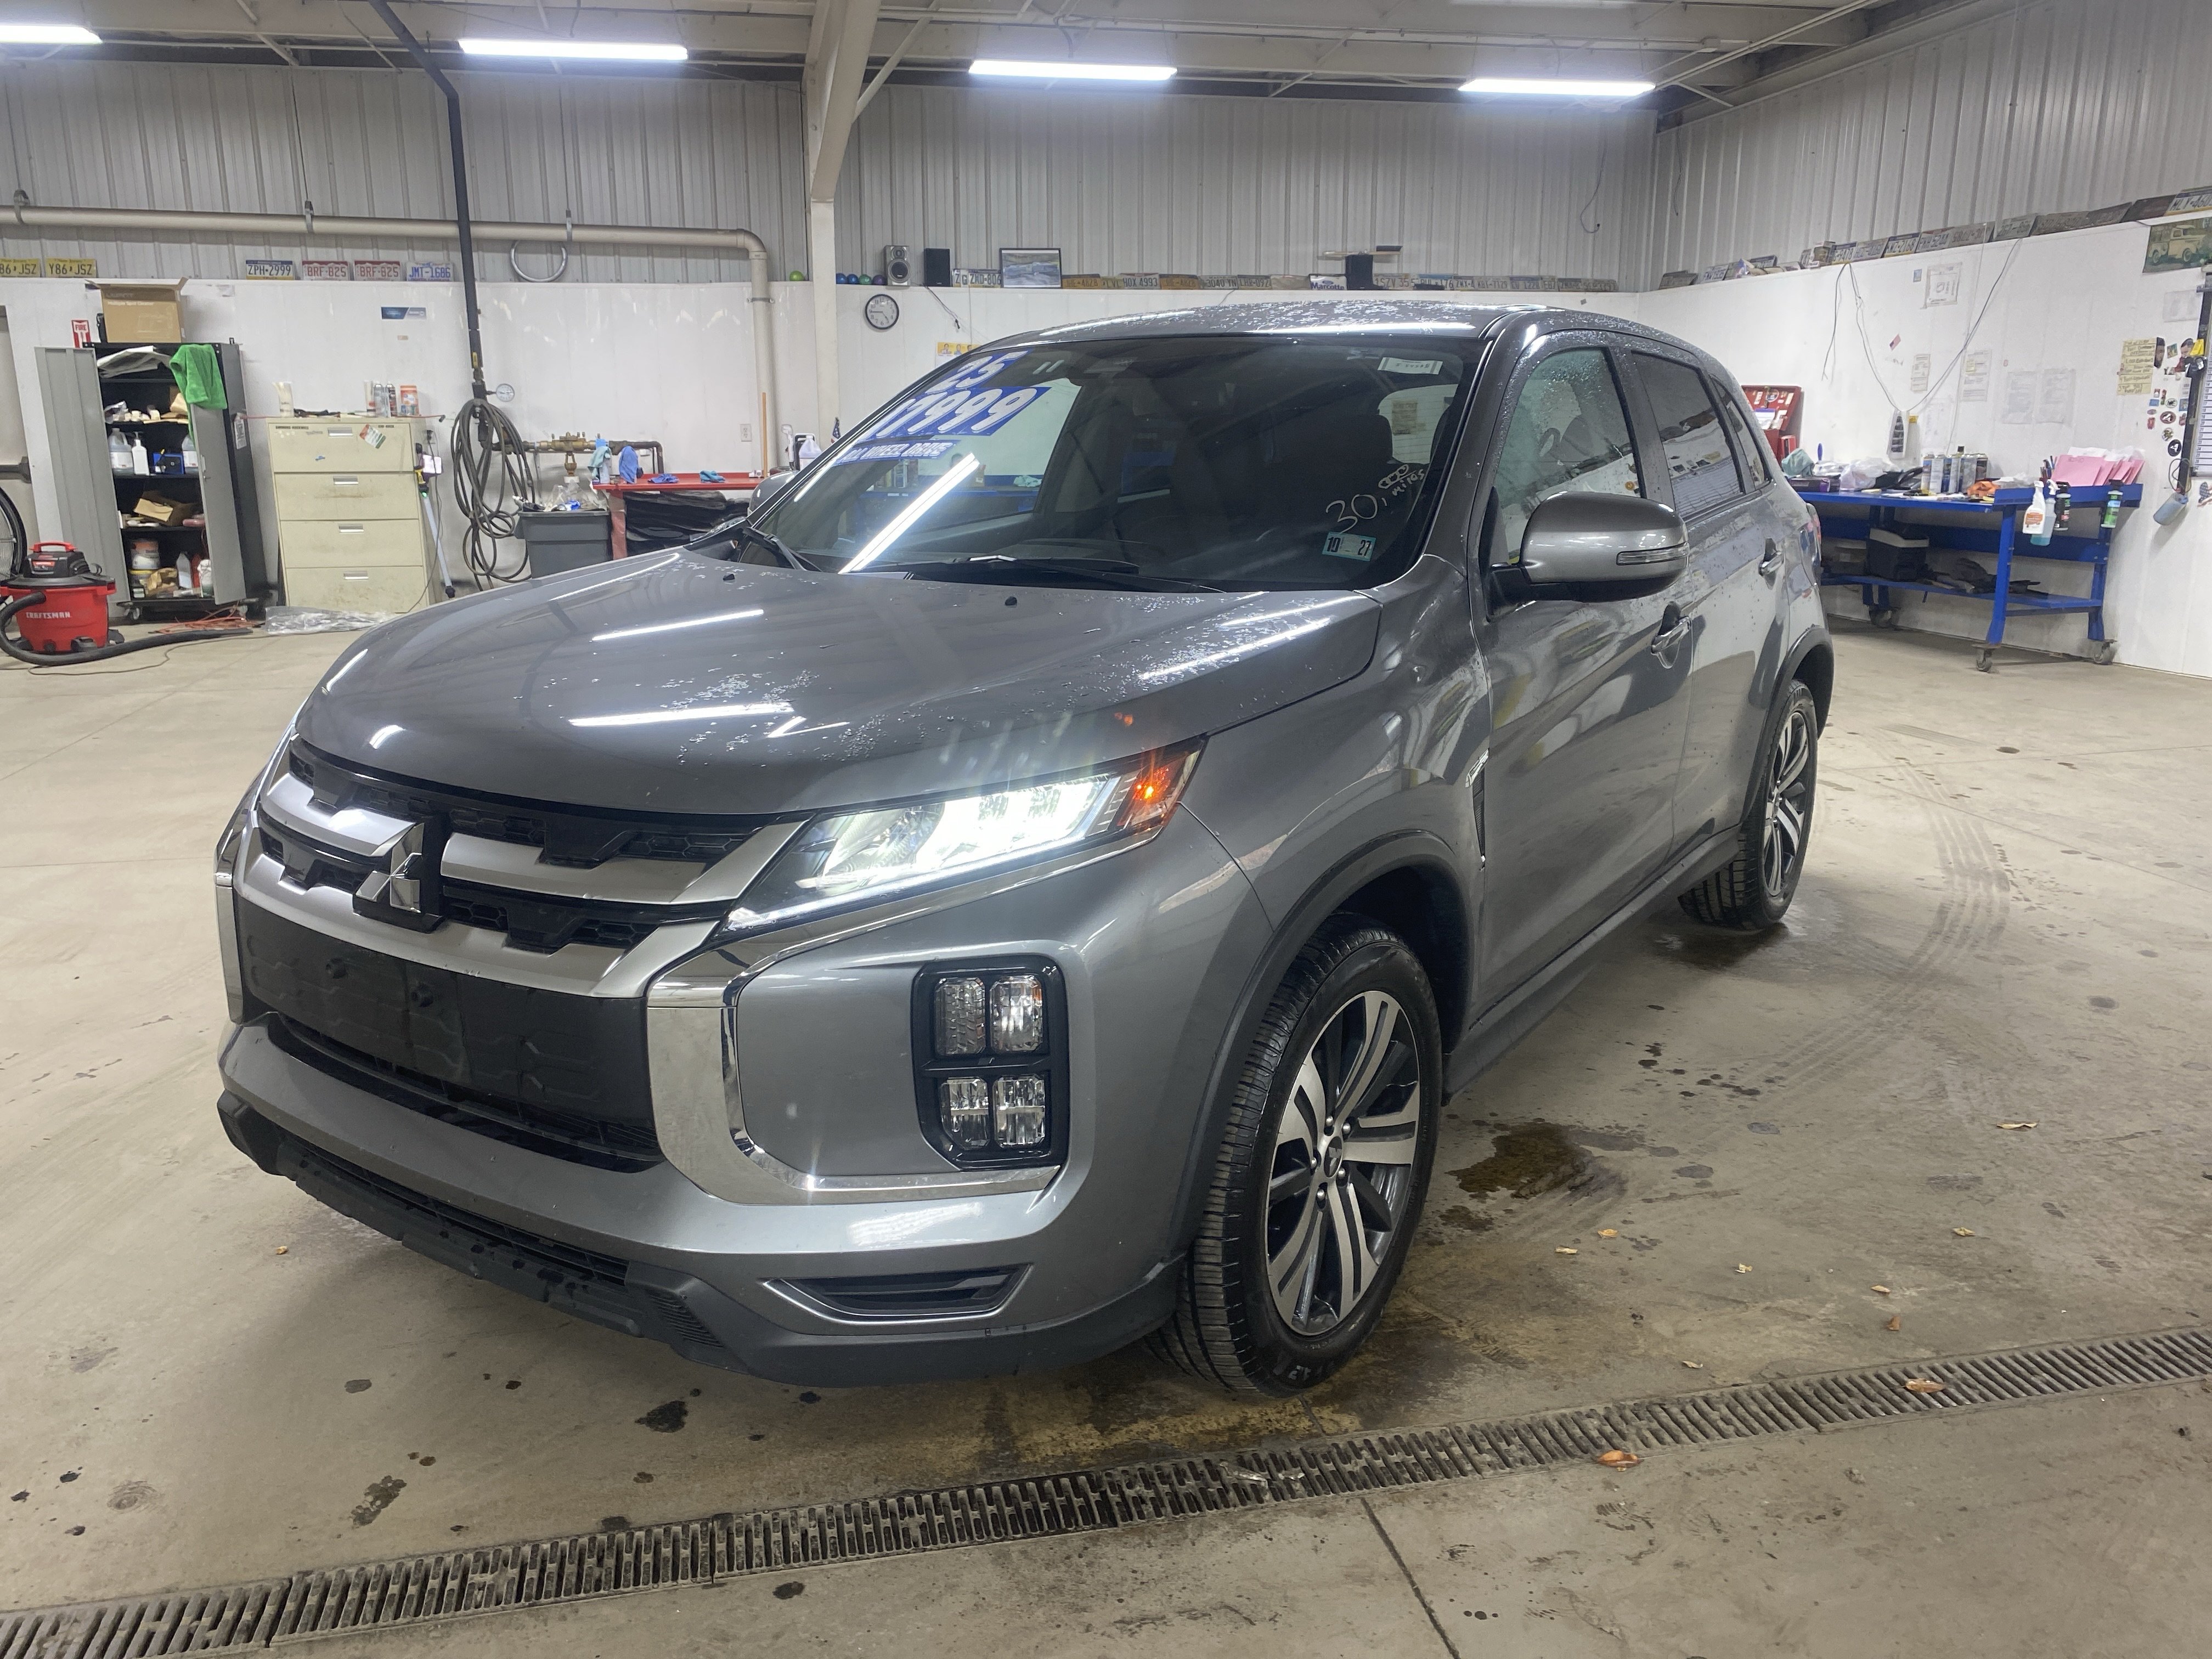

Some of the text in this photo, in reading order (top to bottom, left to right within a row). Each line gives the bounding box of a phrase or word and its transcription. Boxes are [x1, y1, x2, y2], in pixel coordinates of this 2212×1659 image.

[1310, 282, 1345, 290] Marcotte
[925, 351, 1029, 394] 25
[860, 443, 910, 460] WHEEL
[901, 442, 953, 458] DRIVE
[1327, 537, 1372, 556] 10 27
